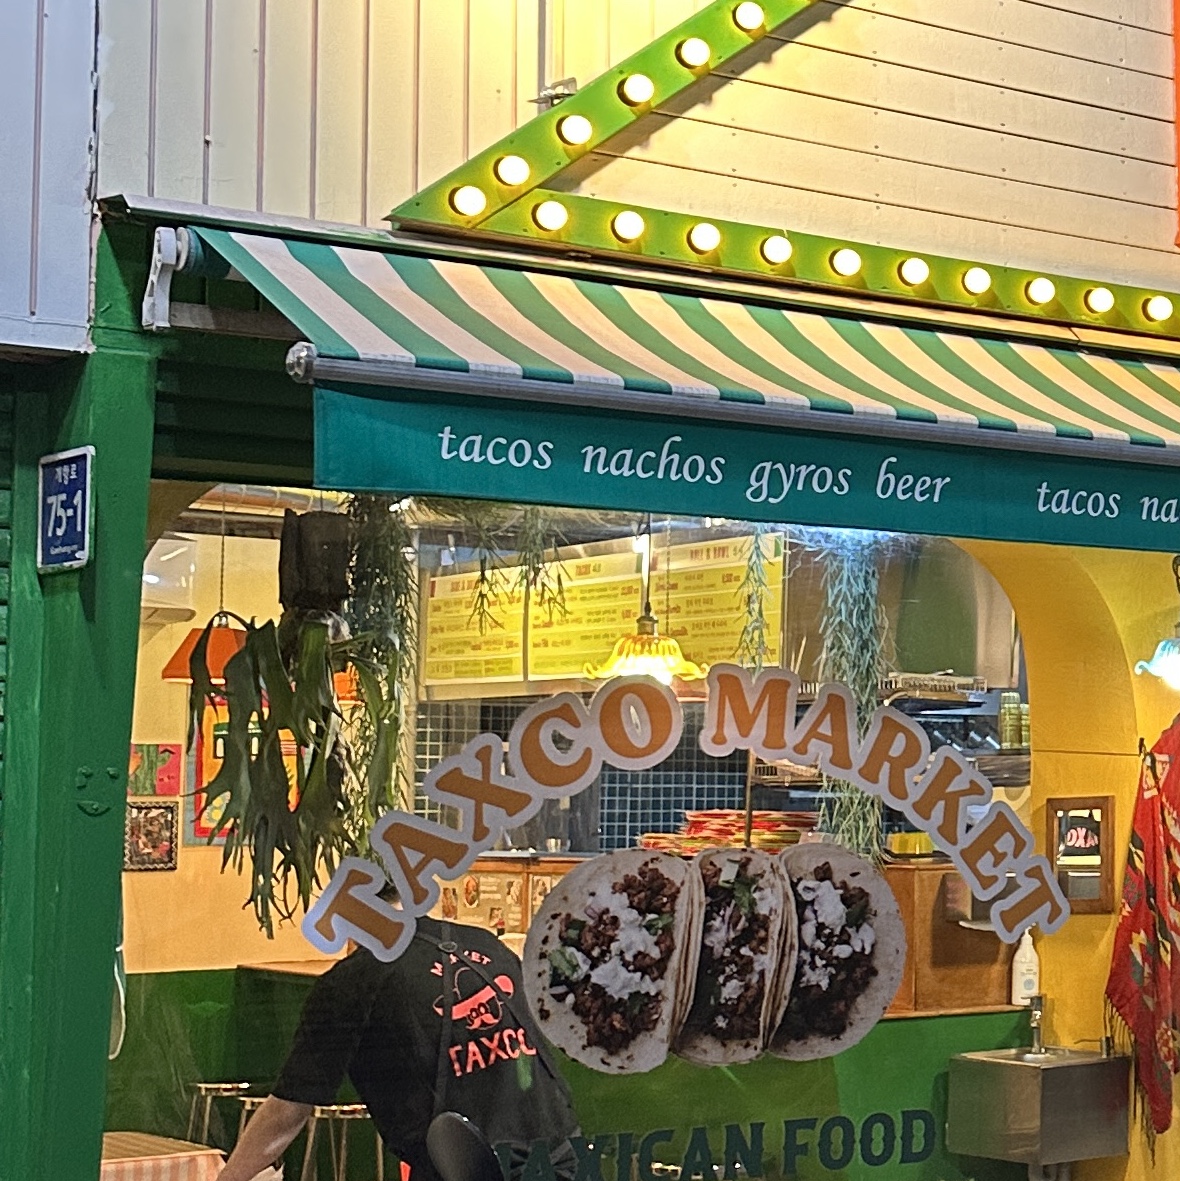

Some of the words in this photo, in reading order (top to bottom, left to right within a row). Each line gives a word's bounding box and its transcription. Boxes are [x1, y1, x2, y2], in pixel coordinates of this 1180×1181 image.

[438, 426, 553, 469] tacos
[582, 436, 725, 485] nachos
[746, 459, 852, 504] gyros
[876, 457, 950, 503] beer
[46, 489, 83, 537] 75-1
[1037, 482, 1120, 518] tacos
[313, 682, 675, 953] TAXCO
[710, 672, 1058, 935] MARKET
[783, 1109, 936, 1176] FOOD
